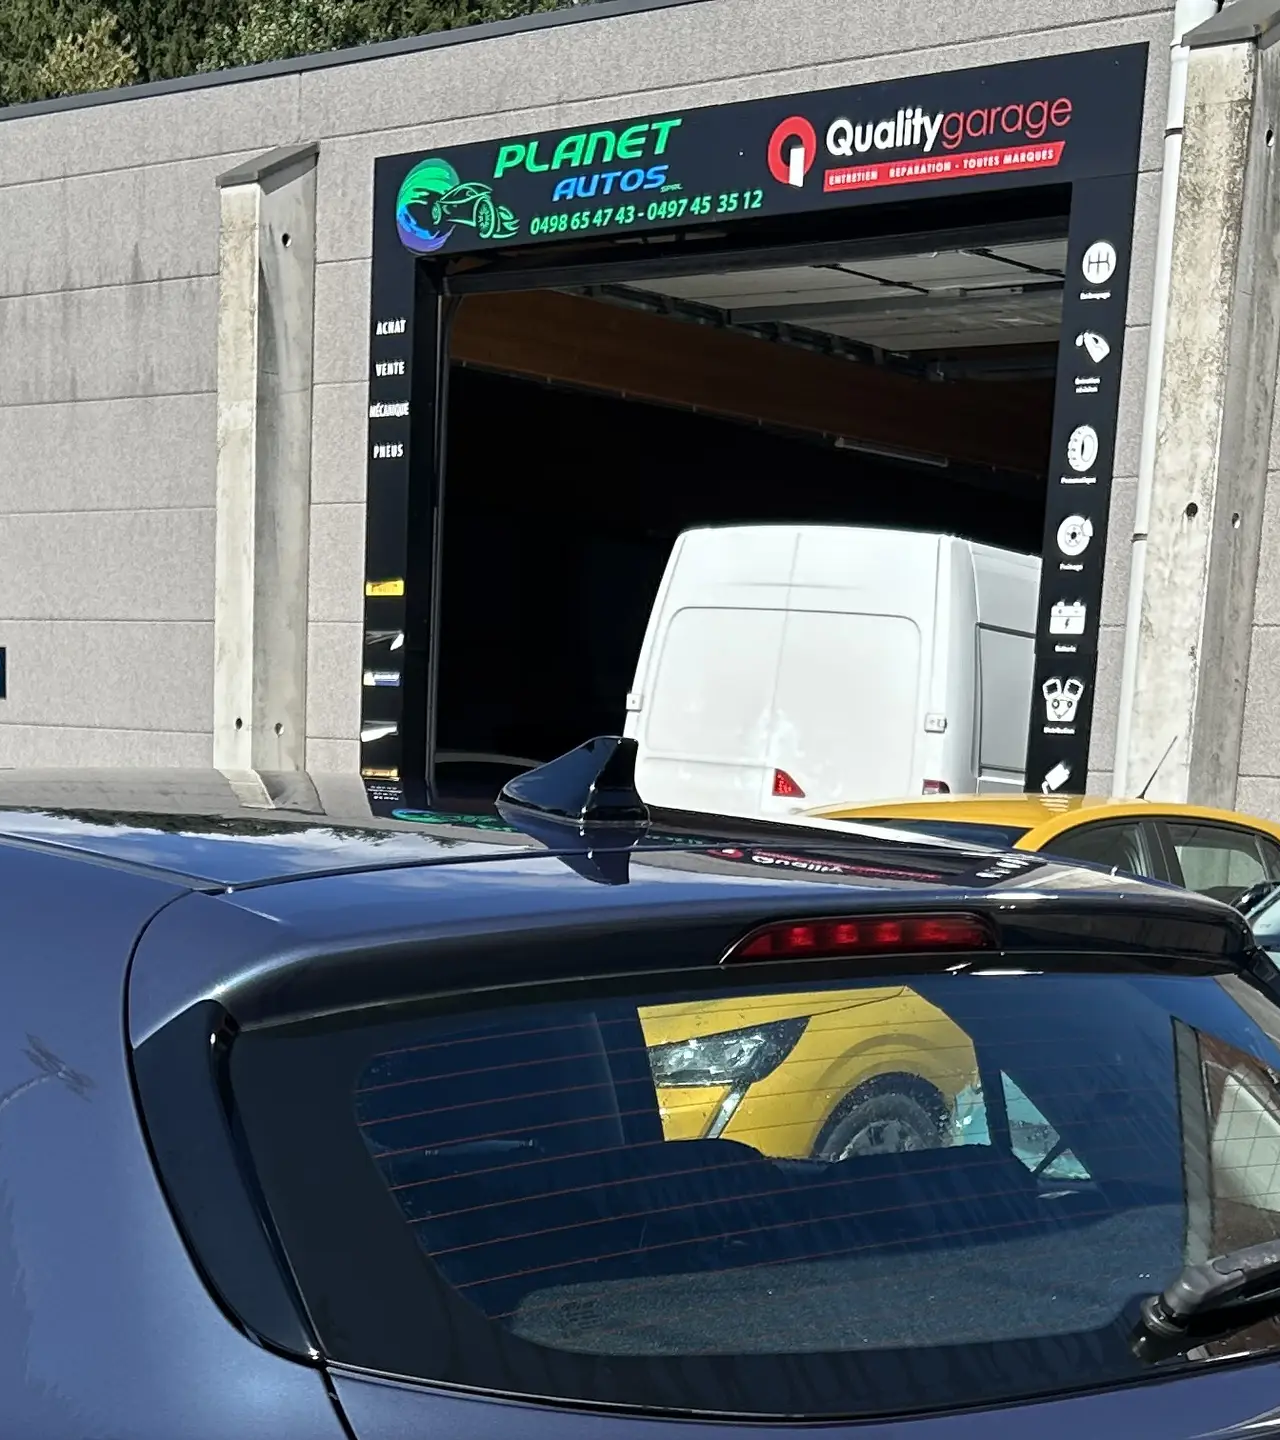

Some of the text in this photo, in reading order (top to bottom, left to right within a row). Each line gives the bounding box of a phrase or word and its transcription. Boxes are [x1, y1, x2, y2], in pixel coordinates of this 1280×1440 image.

[493, 119, 682, 179] PLANET
[828, 169, 878, 186] ENTRETIEN
[889, 161, 951, 179] REPARATION
[963, 155, 1000, 170] TOUTES
[1003, 148, 1054, 166] MARQUES
[552, 165, 669, 202] AUTOS
[530, 213, 568, 235] 0498
[570, 210, 590, 230] 65
[592, 208, 612, 229] 47
[614, 205, 635, 225] 43
[647, 197, 689, 221] 0497
[690, 195, 711, 216] 45
[716, 193, 739, 214] 35
[743, 189, 764, 210] 12
[376, 319, 406, 336] ACHAT
[376, 360, 405, 377] VENTE
[373, 444, 404, 459] PNEUS
